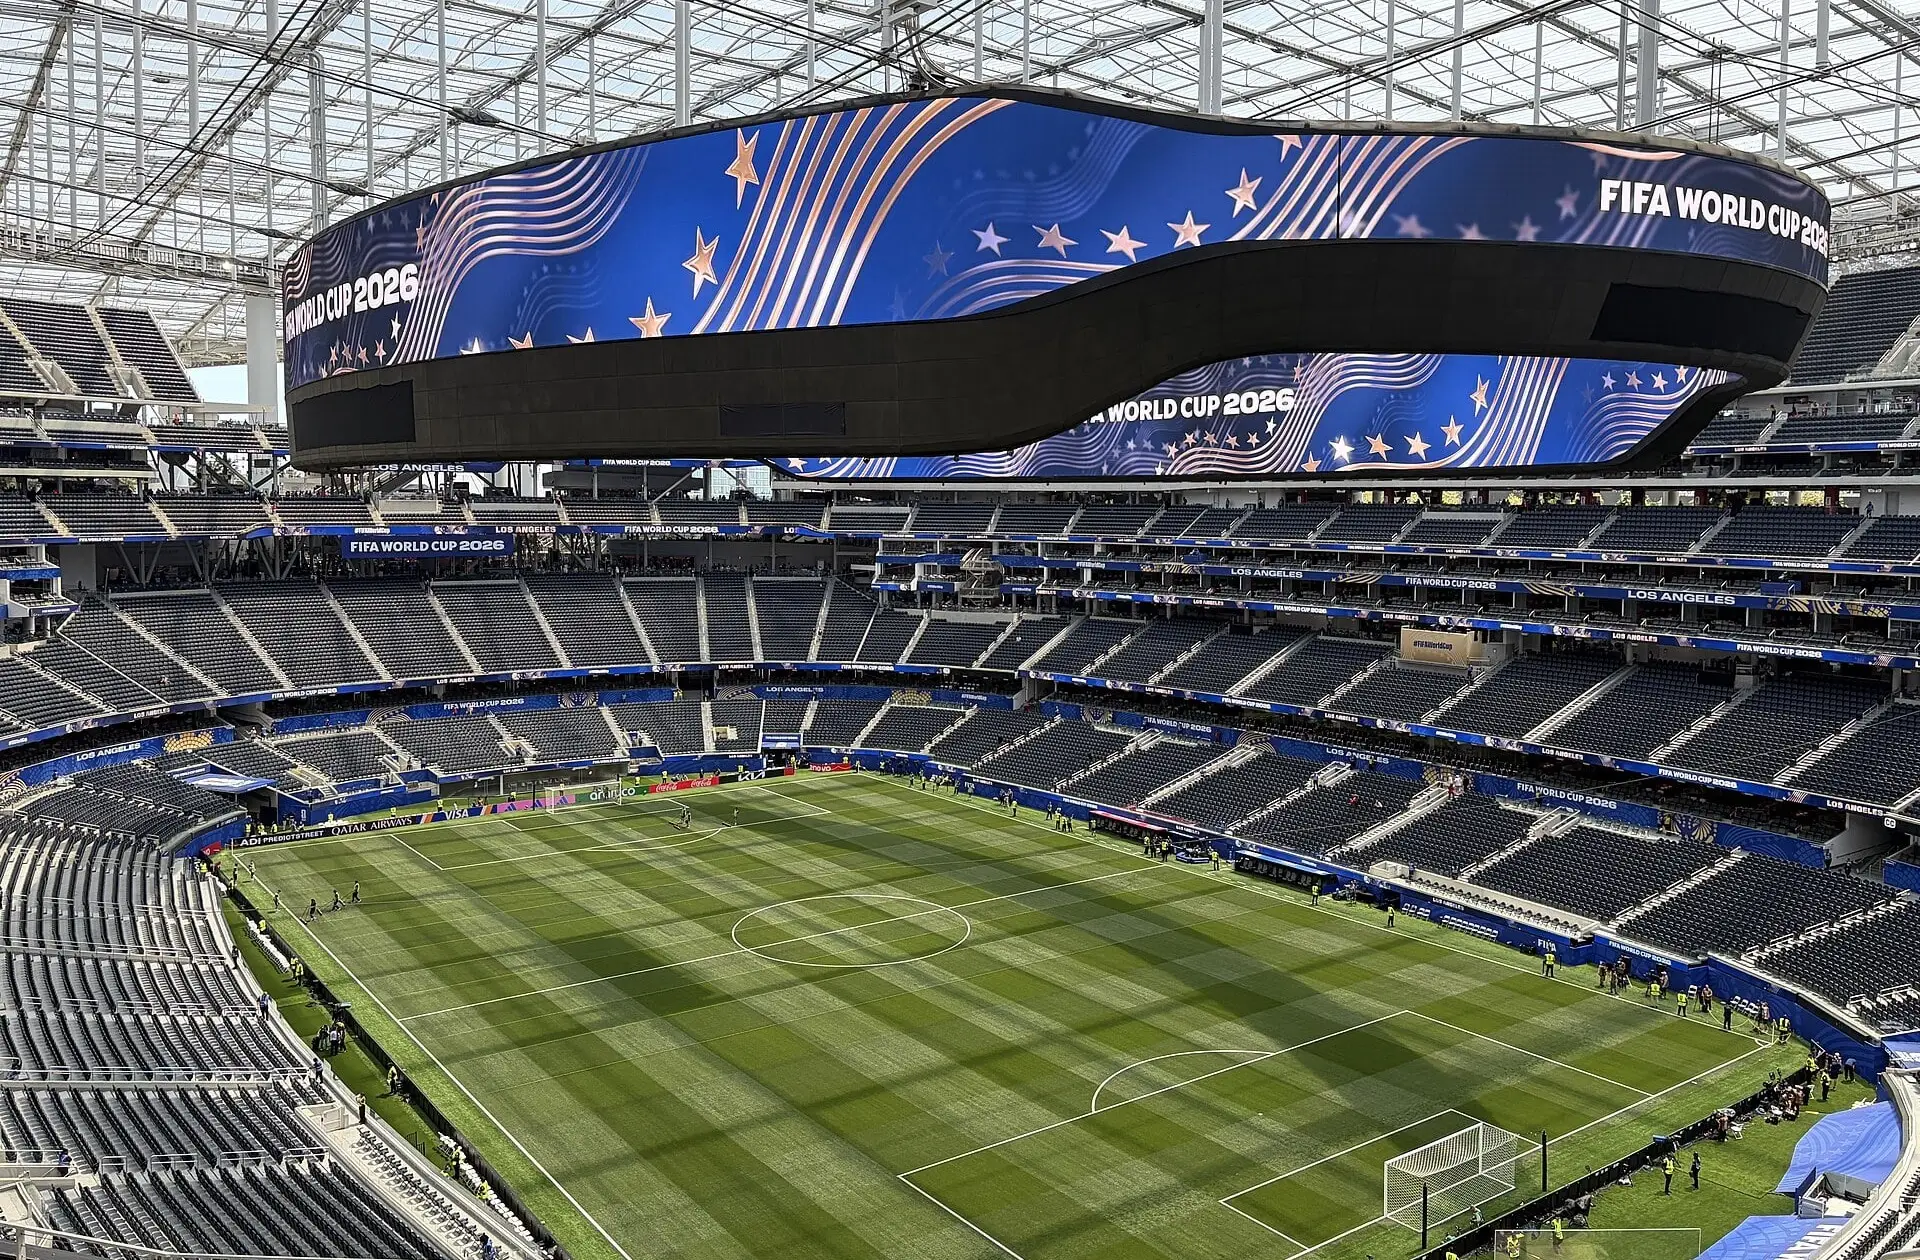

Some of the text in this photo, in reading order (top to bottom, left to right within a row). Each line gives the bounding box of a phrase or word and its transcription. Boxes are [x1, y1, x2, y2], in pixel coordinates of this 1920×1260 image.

[1600, 178, 1670, 217] FIFA
[1675, 187, 1765, 230] WORLD
[1768, 203, 1800, 240] CUP
[296, 293, 324, 338] WORLD
[326, 282, 350, 321] CUP
[354, 264, 420, 313] 2026
[1108, 398, 1178, 422] WORLD
[1180, 395, 1220, 418] CUP
[1223, 388, 1294, 416] 2026
[350, 540, 505, 552] FIFA WORLD CUP 2026
[1253, 569, 1303, 578] ANGELES
[1423, 578, 1450, 586] WORLD
[1468, 581, 1496, 589] 2026
[1628, 590, 1735, 605] LOS ANGELES
[1626, 634, 1658, 642] ANGELES
[1752, 645, 1779, 654] WORLD
[1157, 718, 1177, 727] WORLD
[1191, 724, 1212, 732] 2026
[77, 742, 141, 761] LOS ANGELES
[1326, 747, 1389, 764] LOS ANGELES
[1555, 750, 1584, 760] ANGELES
[1659, 768, 1673, 777] FIFA
[1673, 771, 1697, 781] WORLD
[1698, 776, 1712, 784] CUP
[1517, 782, 1617, 809] FIFA WORLD CUP 2026
[445, 809, 469, 820] VISA
[1827, 800, 1884, 816] LOS ANGELES
[332, 818, 412, 836] QATAR AIRWAYS
[240, 837, 261, 846] ADI
[1621, 943, 1640, 955] WORLD
[1641, 950, 1651, 959] CUP
